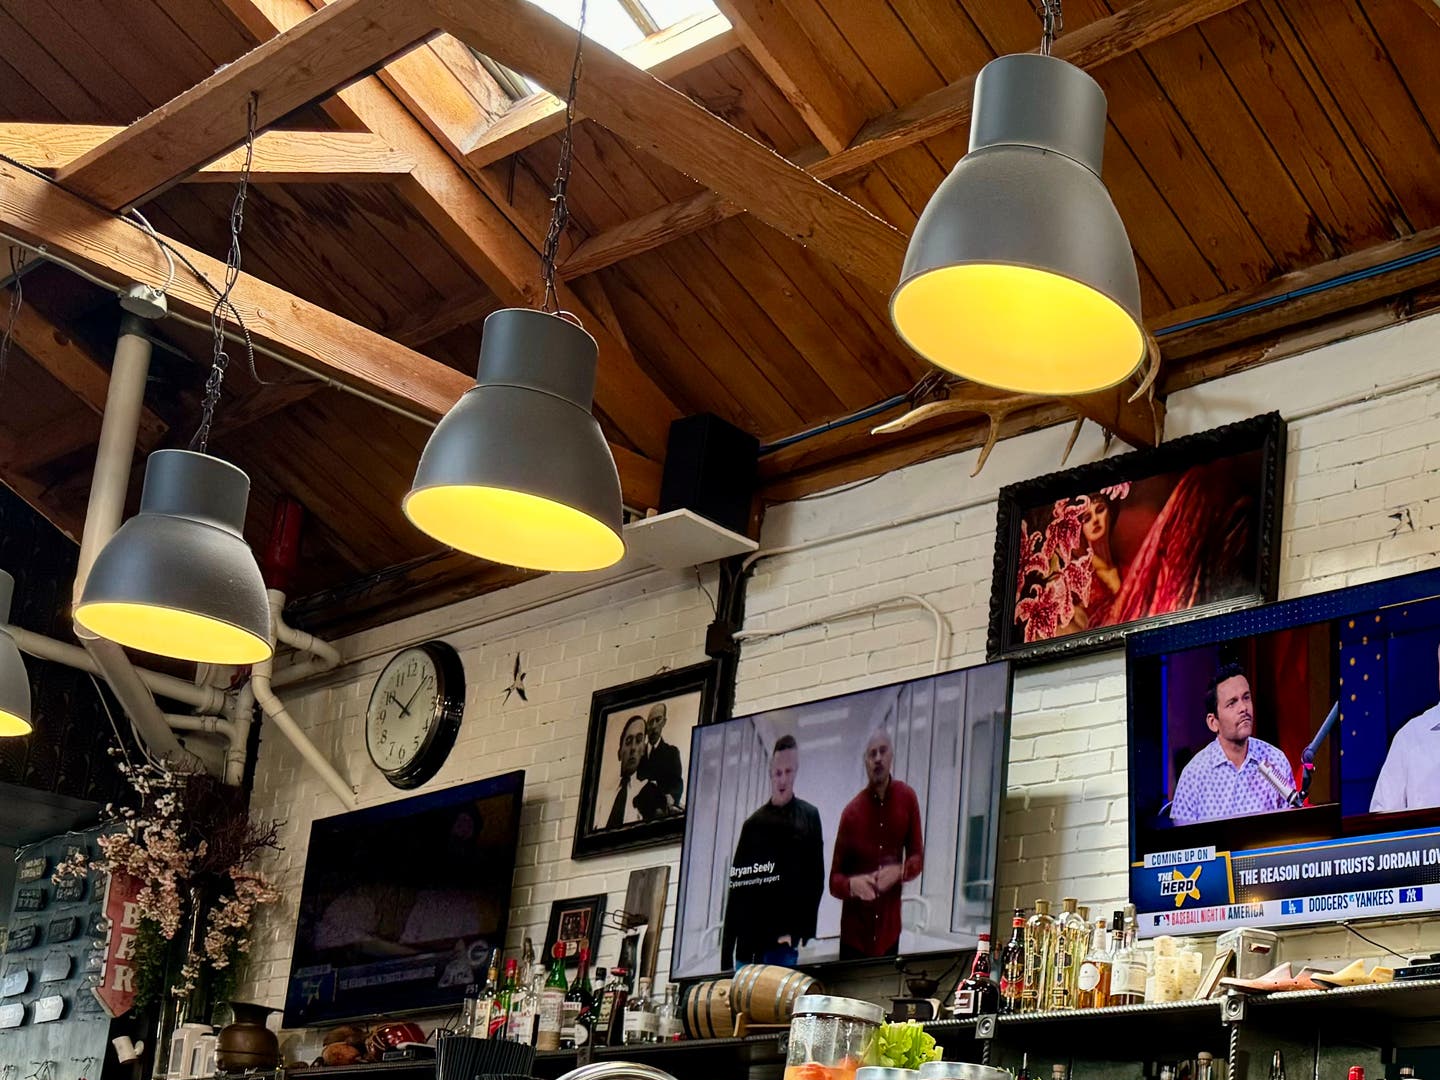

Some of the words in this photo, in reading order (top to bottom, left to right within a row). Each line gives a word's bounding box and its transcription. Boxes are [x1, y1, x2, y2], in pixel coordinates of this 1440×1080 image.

[396, 669, 406, 688] 11
[407, 662, 418, 678] 12
[426, 675, 434, 690] 2
[1151, 852, 1183, 866] COMING
[1185, 849, 1196, 863] UP
[1198, 848, 1209, 861] ON
[730, 865, 753, 878] Bryan
[753, 860, 776, 874] Seely
[1158, 871, 1174, 882] THE
[1239, 870, 1259, 887] THE
[1260, 864, 1300, 884] REASON
[1301, 861, 1332, 880] COLIN
[1334, 855, 1375, 875] TRUSTS
[1377, 850, 1420, 871] JORDAN
[763, 874, 781, 884] expert
[1162, 879, 1194, 894] HERD
[1308, 894, 1349, 913] DODGERS
[1355, 889, 1394, 909] YANKEES
[1171, 910, 1200, 926] BASEBALL
[1200, 908, 1218, 923] NIGHT
[1218, 907, 1227, 921] IN
[1227, 903, 1265, 920] AMERICA
